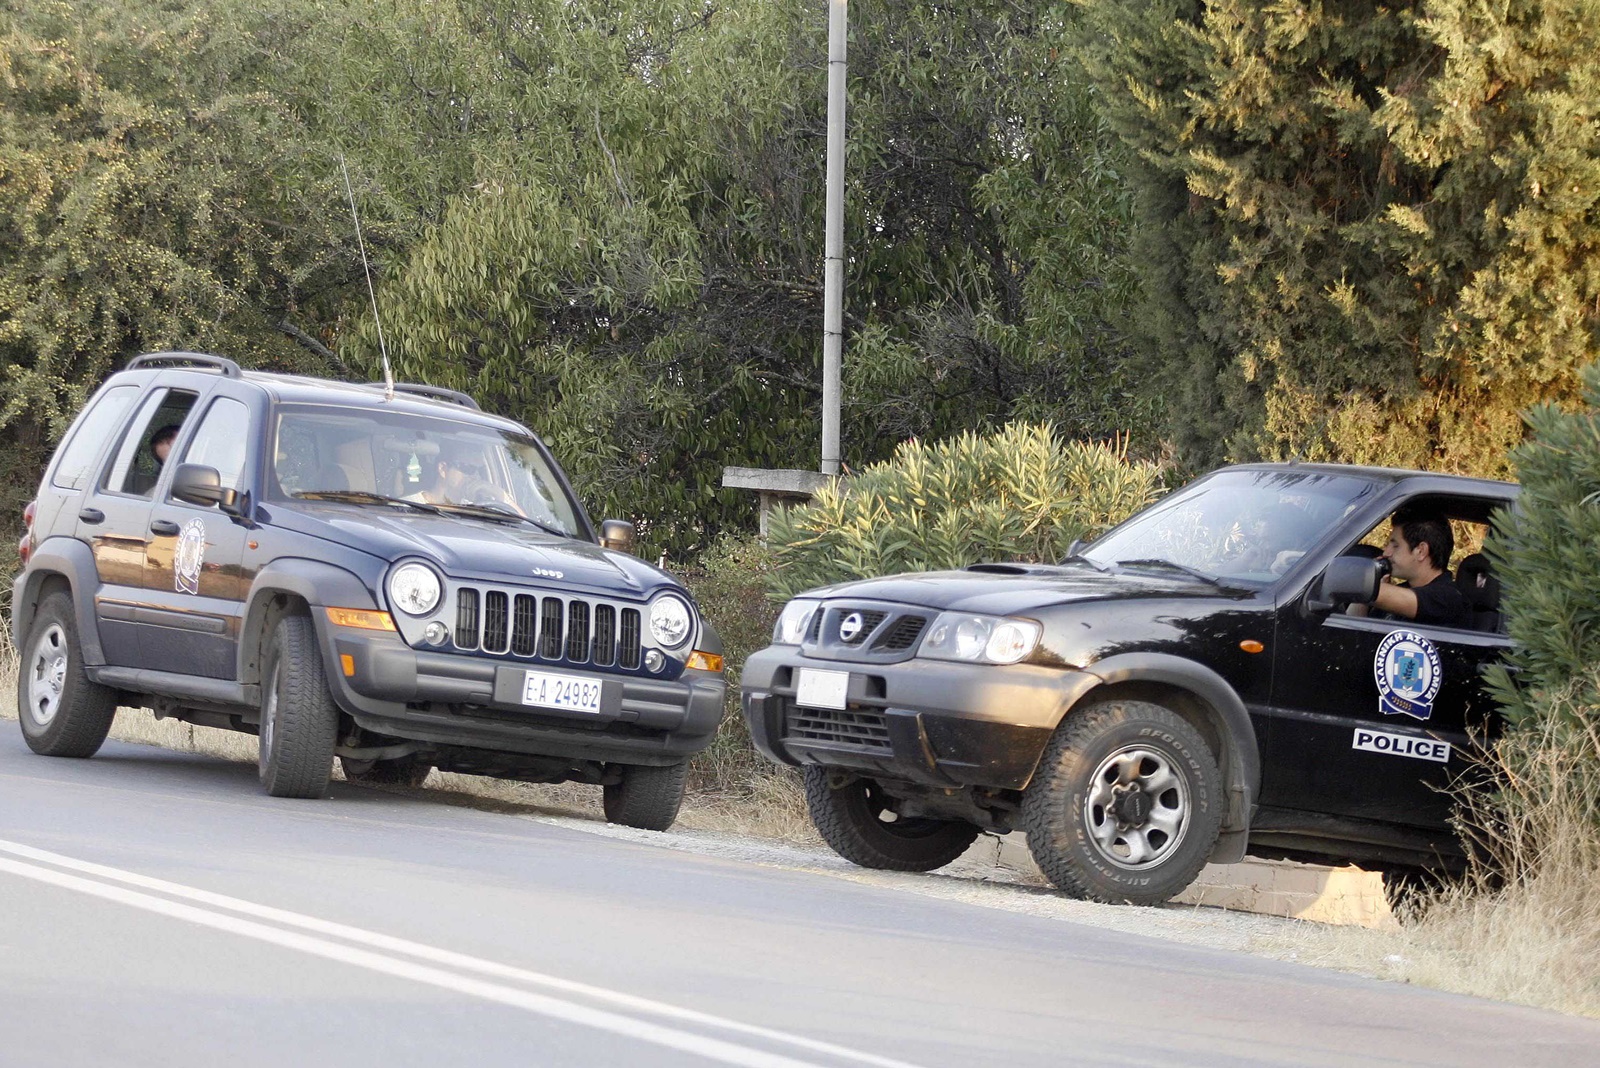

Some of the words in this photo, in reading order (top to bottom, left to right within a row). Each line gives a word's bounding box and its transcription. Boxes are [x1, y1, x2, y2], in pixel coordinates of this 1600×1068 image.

[532, 567, 564, 579] Jeep
[1376, 633, 1403, 696] ΕΛΛΗΝΙΚΗ
[1406, 633, 1440, 700] ΑΣΤΥΝΟΜΙΑ
[555, 680, 599, 708] 24982
[1357, 732, 1447, 759] POLICE
